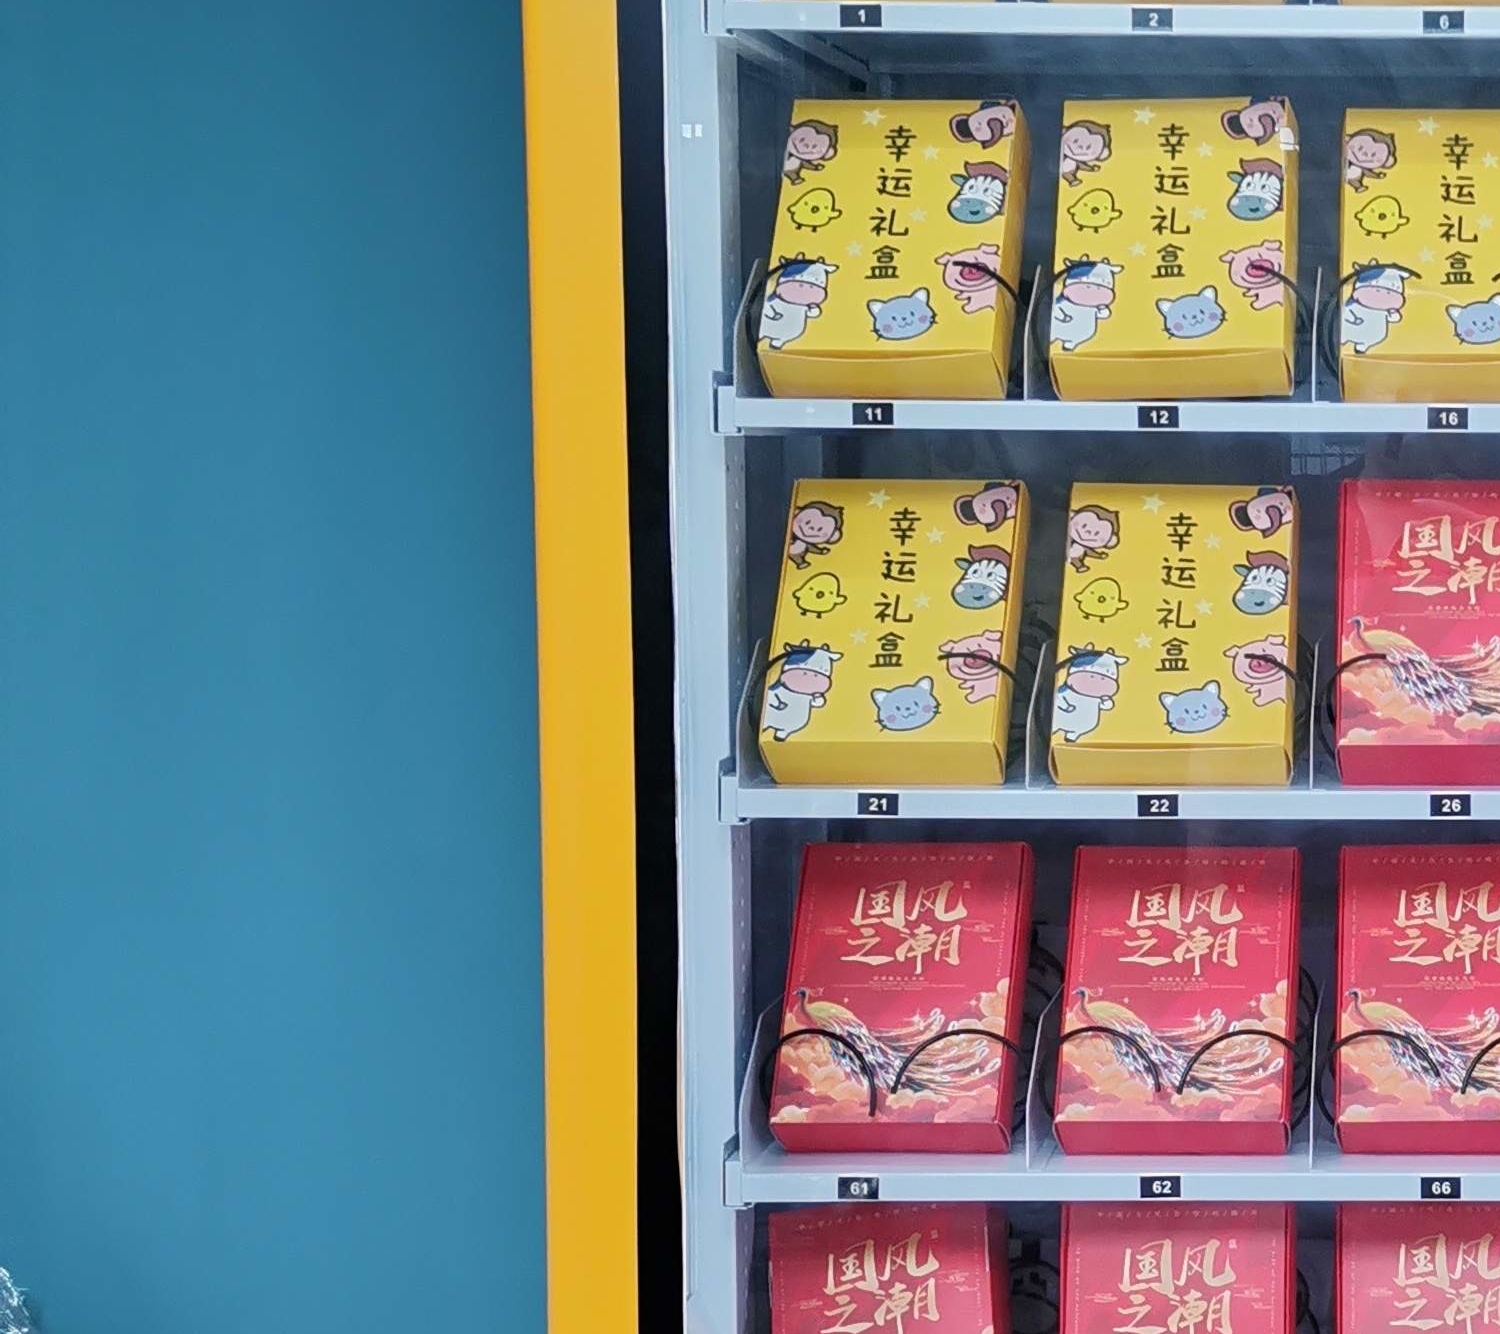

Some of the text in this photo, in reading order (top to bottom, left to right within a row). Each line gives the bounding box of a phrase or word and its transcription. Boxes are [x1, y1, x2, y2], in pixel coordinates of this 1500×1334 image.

[858, 10, 866, 23] 1
[1149, 13, 1159, 26] 2
[1440, 15, 1449, 29] 6
[864, 125, 917, 280] 幸运礼盒
[1150, 124, 1191, 280] 幸运礼盒
[1438, 133, 1478, 286] 幸运礼盒
[864, 408, 882, 420] 11
[1150, 410, 1169, 424] 12
[1439, 412, 1458, 425] 16
[868, 507, 922, 668] 幸运礼盒
[1155, 512, 1198, 673] 幸运礼盒
[869, 797, 887, 811] 21
[1149, 799, 1170, 811] 22
[1442, 799, 1461, 812] 26
[850, 881, 968, 926] 国风
[1126, 882, 1243, 929] 国风
[840, 924, 961, 974] 之潮
[1118, 926, 1238, 976] 之潮
[850, 1182, 868, 1195] 61
[1152, 1180, 1172, 1194] 62
[1431, 1182, 1451, 1195] 66
[823, 1231, 939, 1294] 国风
[1118, 1238, 1237, 1294] 国风
